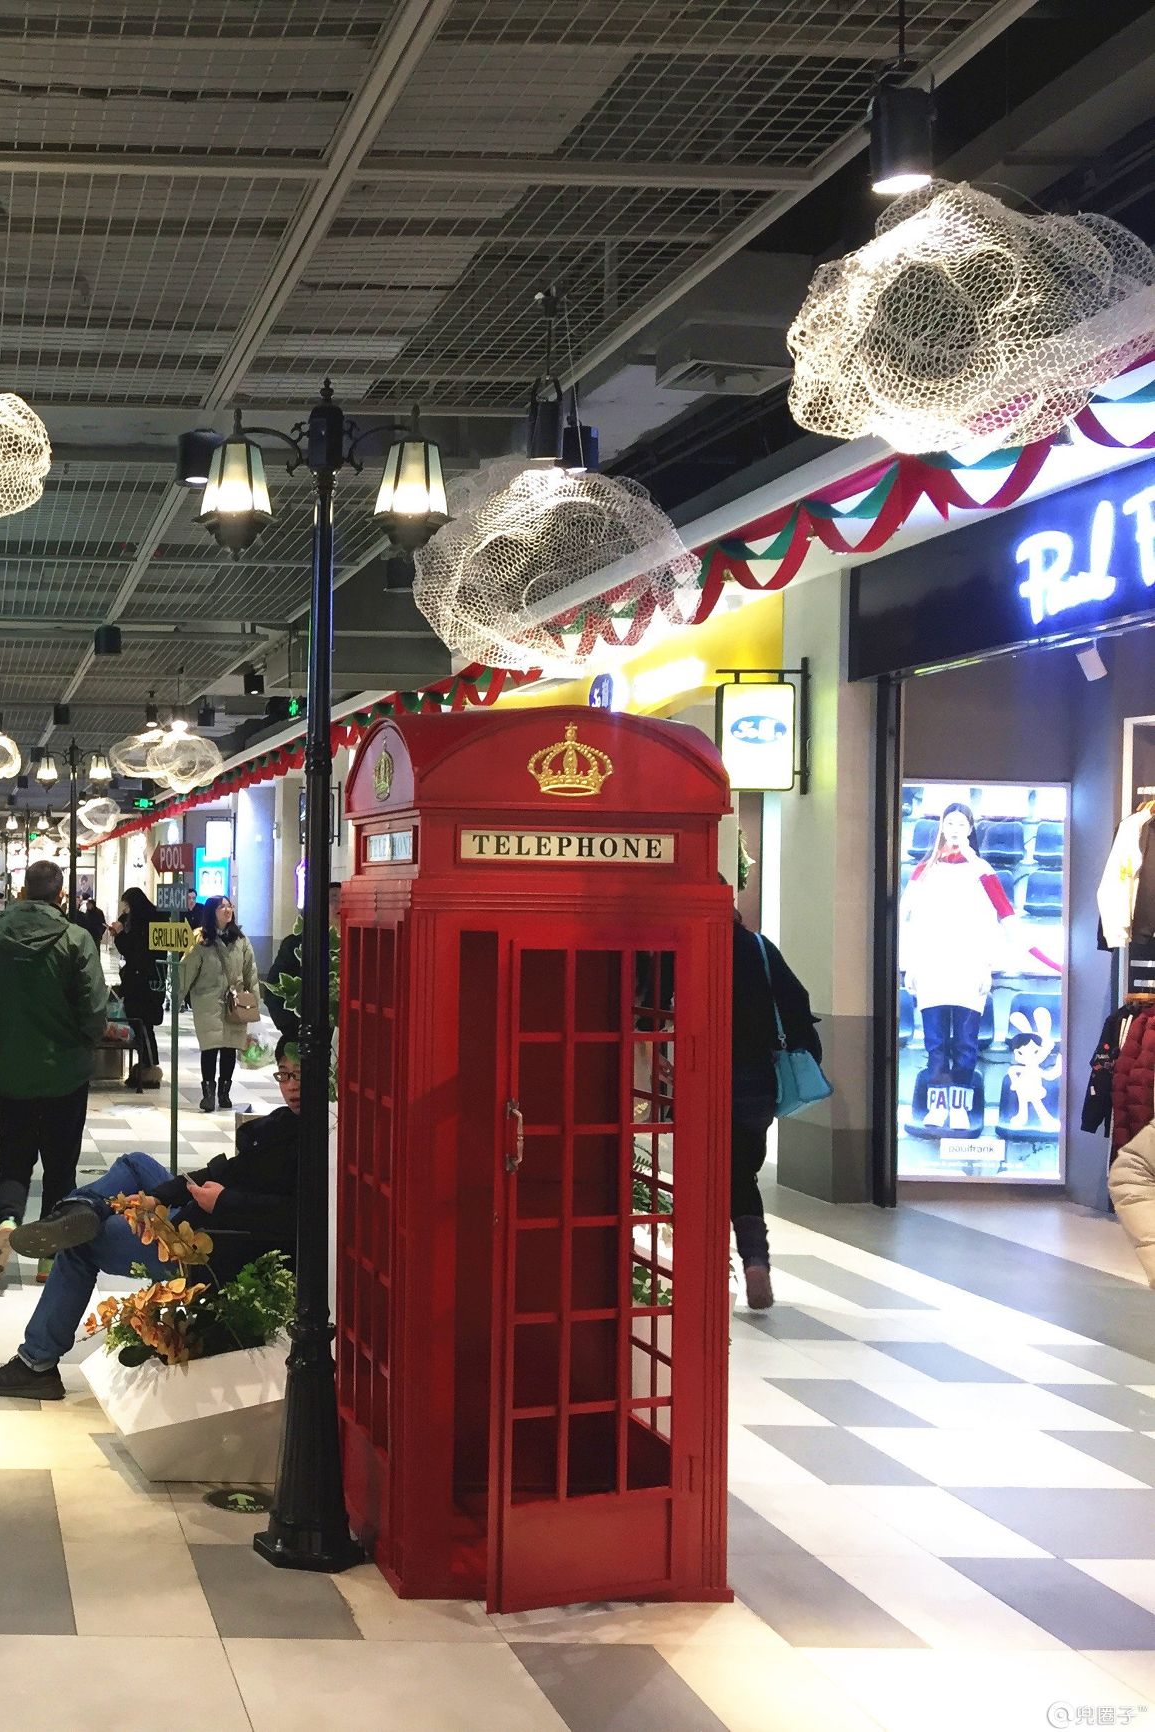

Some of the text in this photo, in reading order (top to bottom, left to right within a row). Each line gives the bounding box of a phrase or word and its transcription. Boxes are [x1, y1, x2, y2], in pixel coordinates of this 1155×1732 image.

[473, 834, 662, 859] TELEPHONE
[160, 847, 186, 869] POOL
[157, 887, 187, 909] BEACH
[152, 927, 189, 948] GRILLING
[930, 1088, 971, 1110] PAUL
